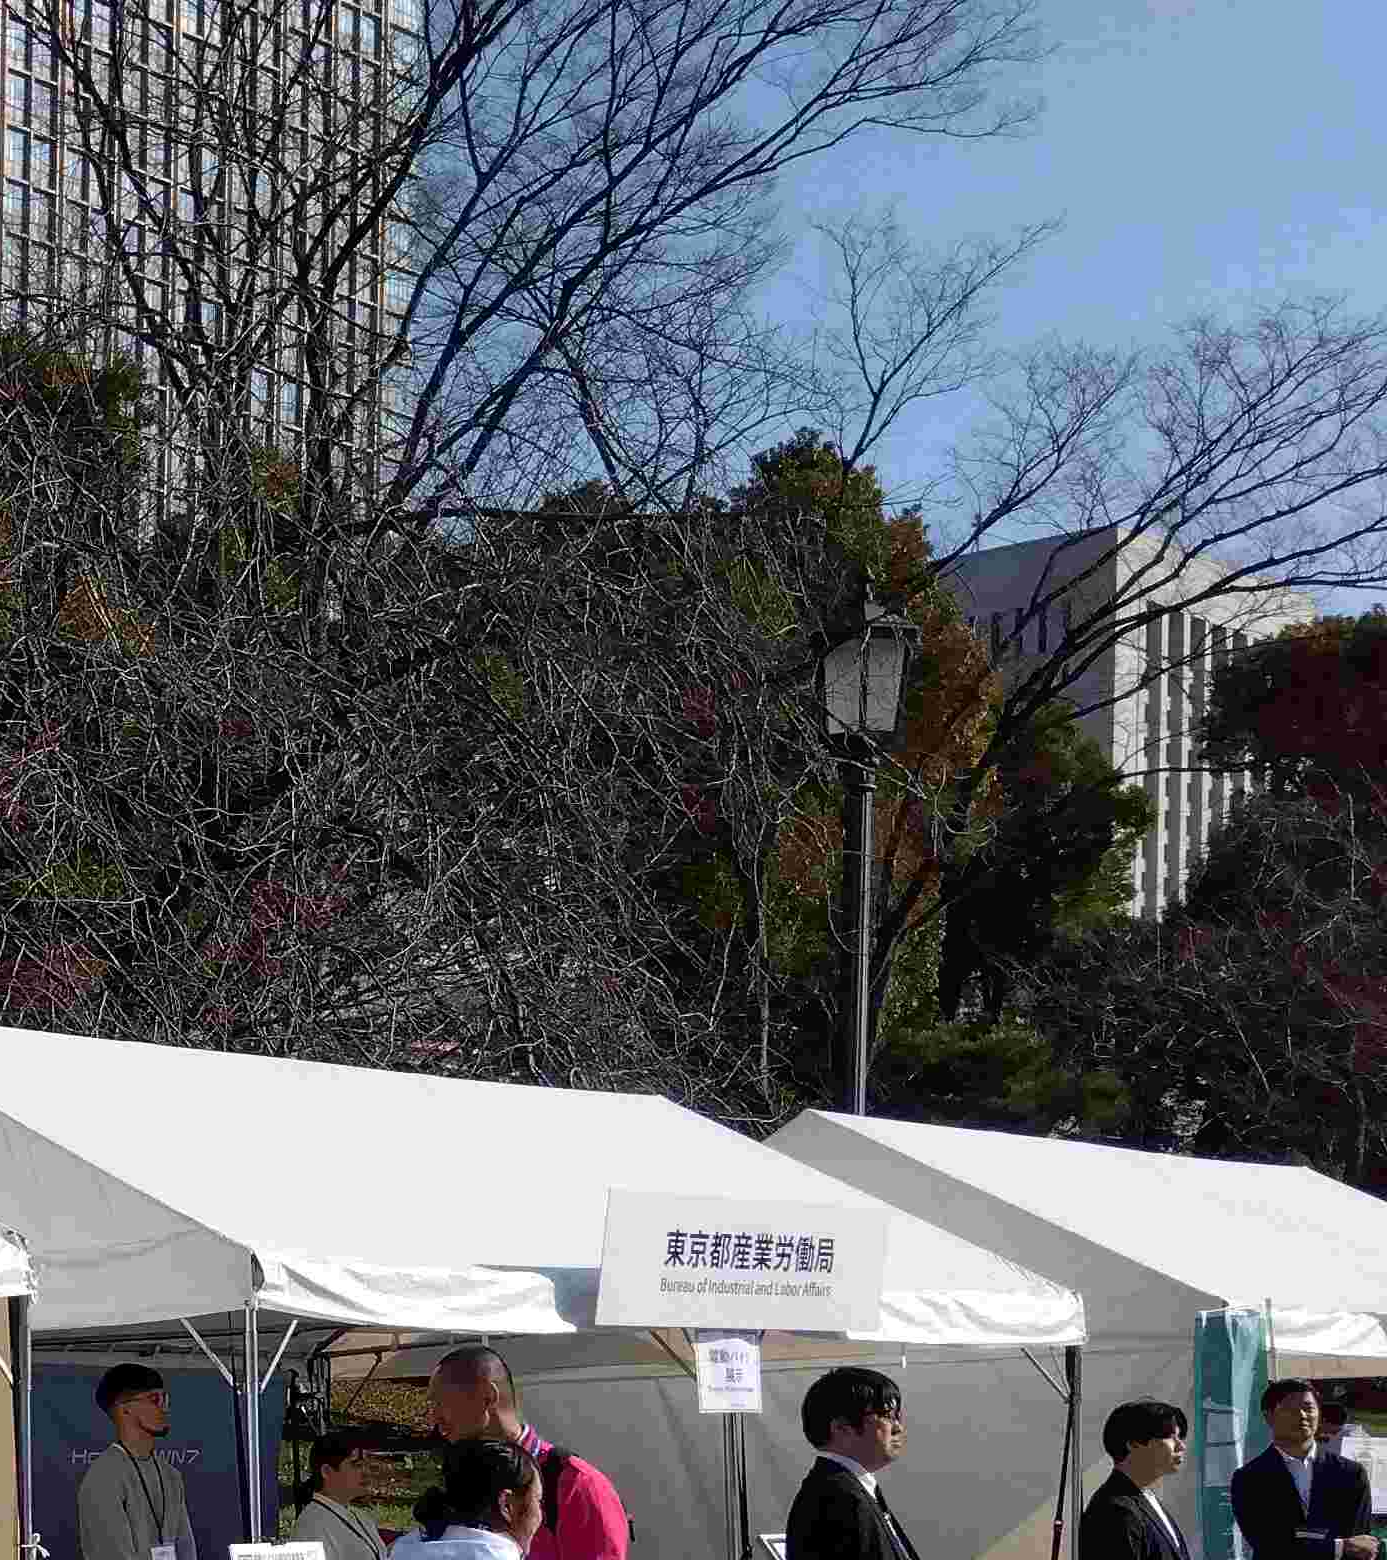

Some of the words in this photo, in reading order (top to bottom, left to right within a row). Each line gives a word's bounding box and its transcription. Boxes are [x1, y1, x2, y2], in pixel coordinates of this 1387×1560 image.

[665, 1230, 835, 1273] 東京都産業労働局
[696, 1278, 708, 1295] of
[708, 1279, 755, 1296] Industrial
